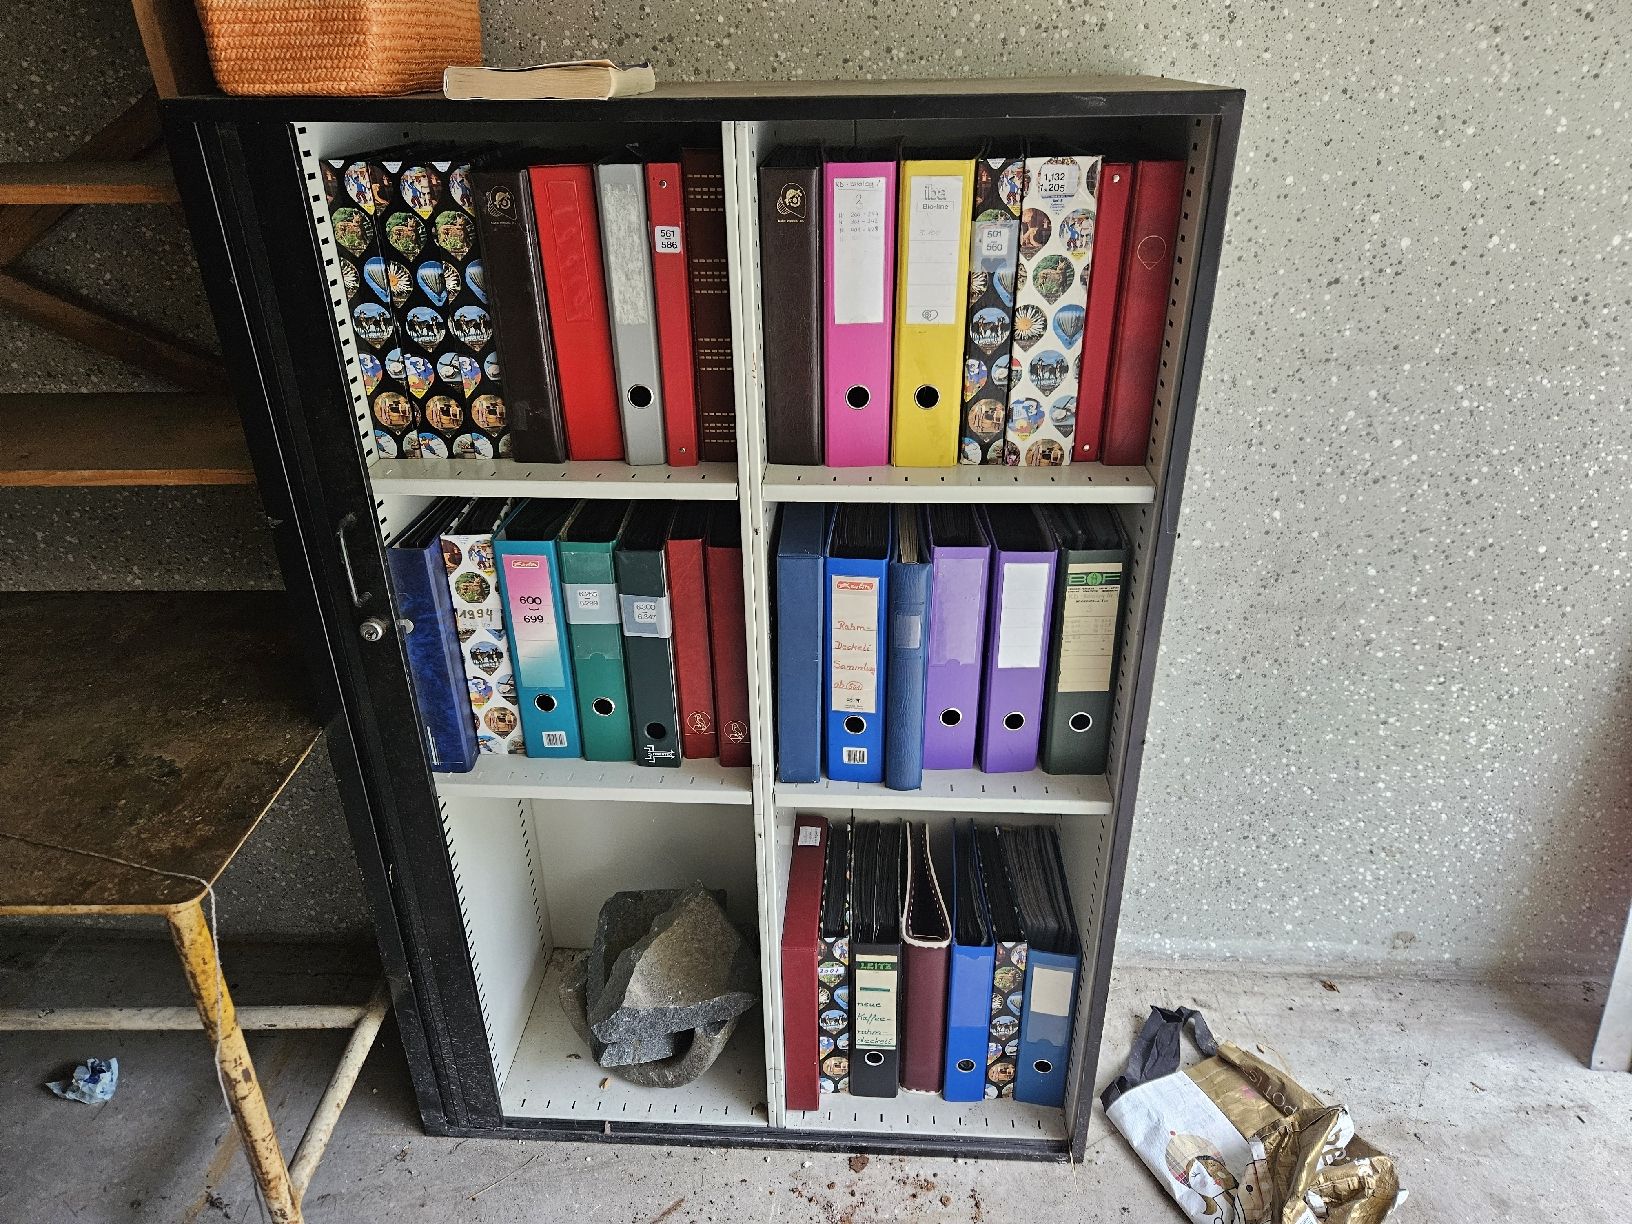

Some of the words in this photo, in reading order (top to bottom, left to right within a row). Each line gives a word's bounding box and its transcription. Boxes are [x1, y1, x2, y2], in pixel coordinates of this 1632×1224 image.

[987, 230, 1002, 238] 501
[661, 241, 678, 249] 586
[986, 243, 1003, 252] 560
[519, 596, 542, 605] 600
[458, 607, 494, 622] 1994
[523, 614, 544, 624] 699
[833, 679, 845, 689] ab
[860, 962, 892, 970] LEITZ
